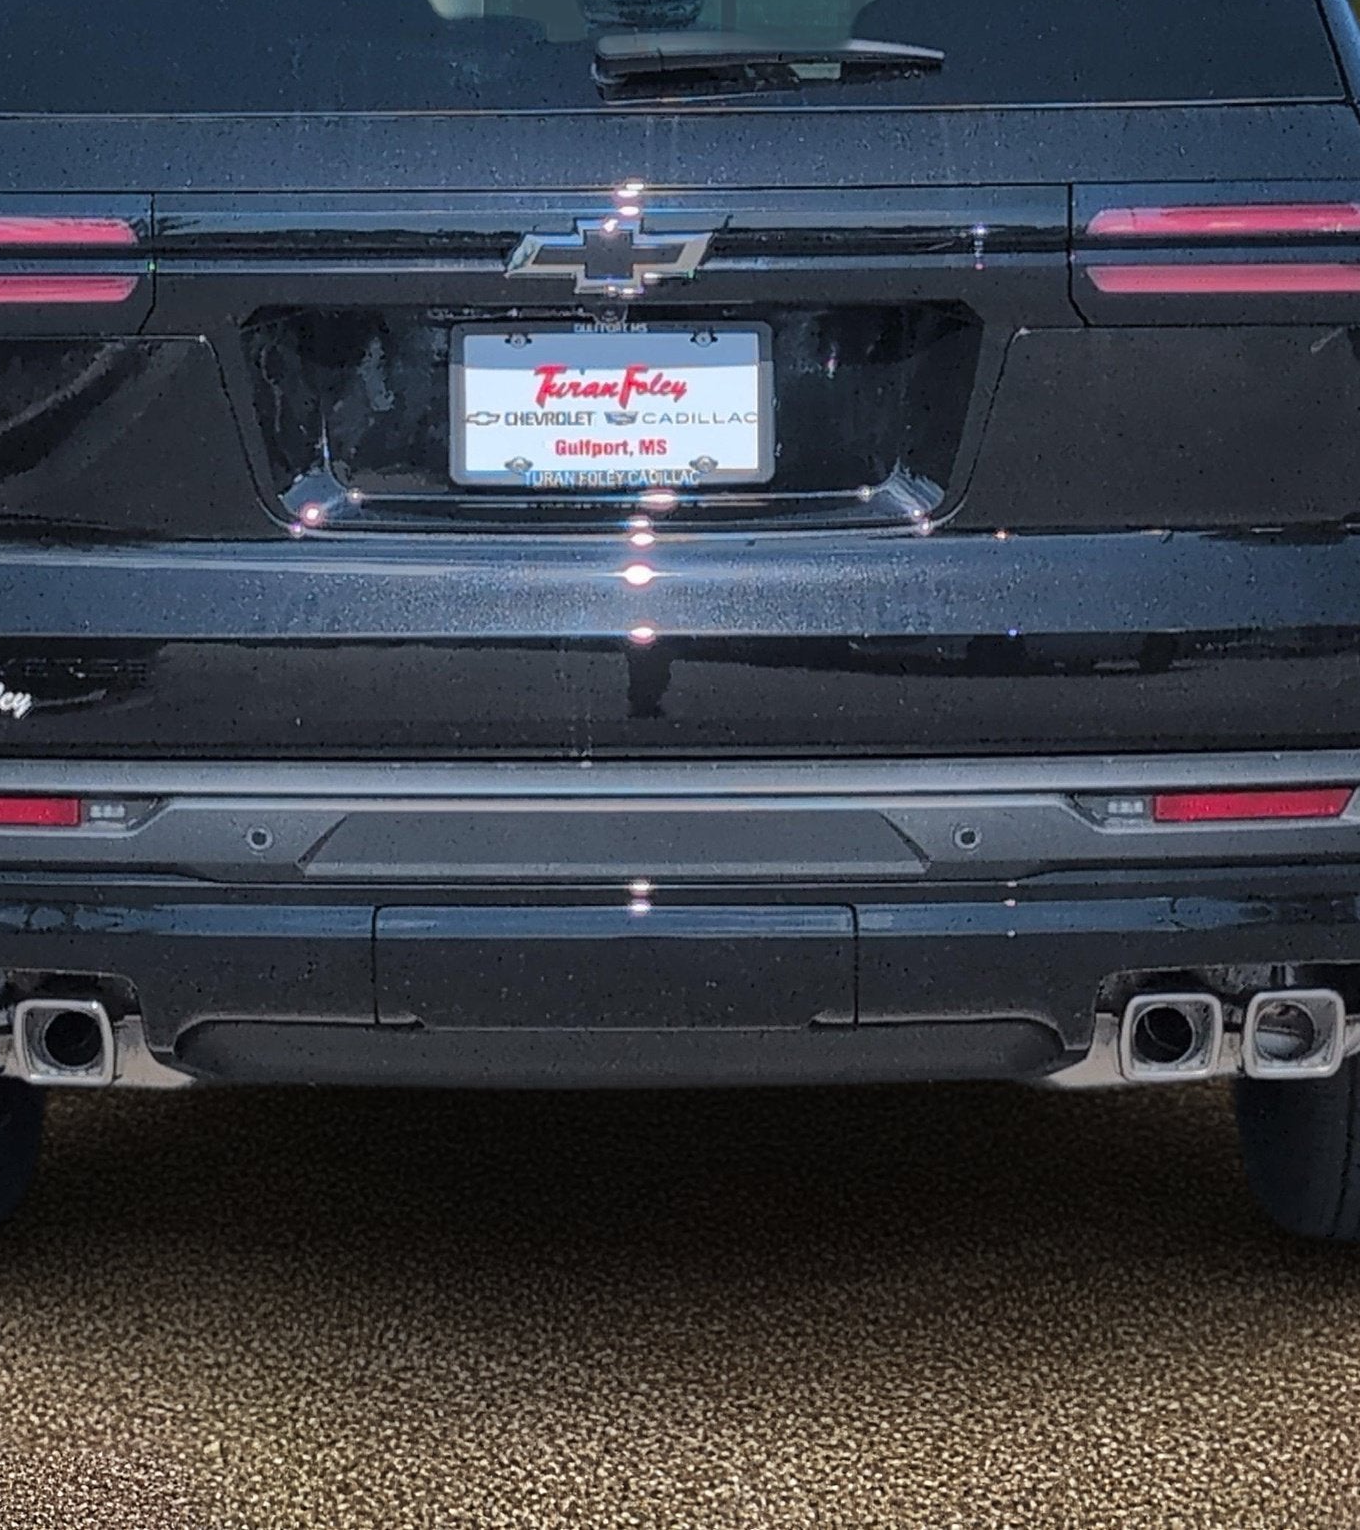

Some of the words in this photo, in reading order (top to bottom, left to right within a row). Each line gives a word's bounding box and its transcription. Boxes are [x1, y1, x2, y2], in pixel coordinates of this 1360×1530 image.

[505, 411, 595, 426] CHEVROLET
[642, 411, 757, 425] CADILLAC
[555, 439, 634, 457] Gulfport,
[640, 439, 667, 455] MS
[524, 470, 574, 487] TURAN
[578, 470, 624, 486] FOLEY
[628, 470, 700, 486] CADILLAC
